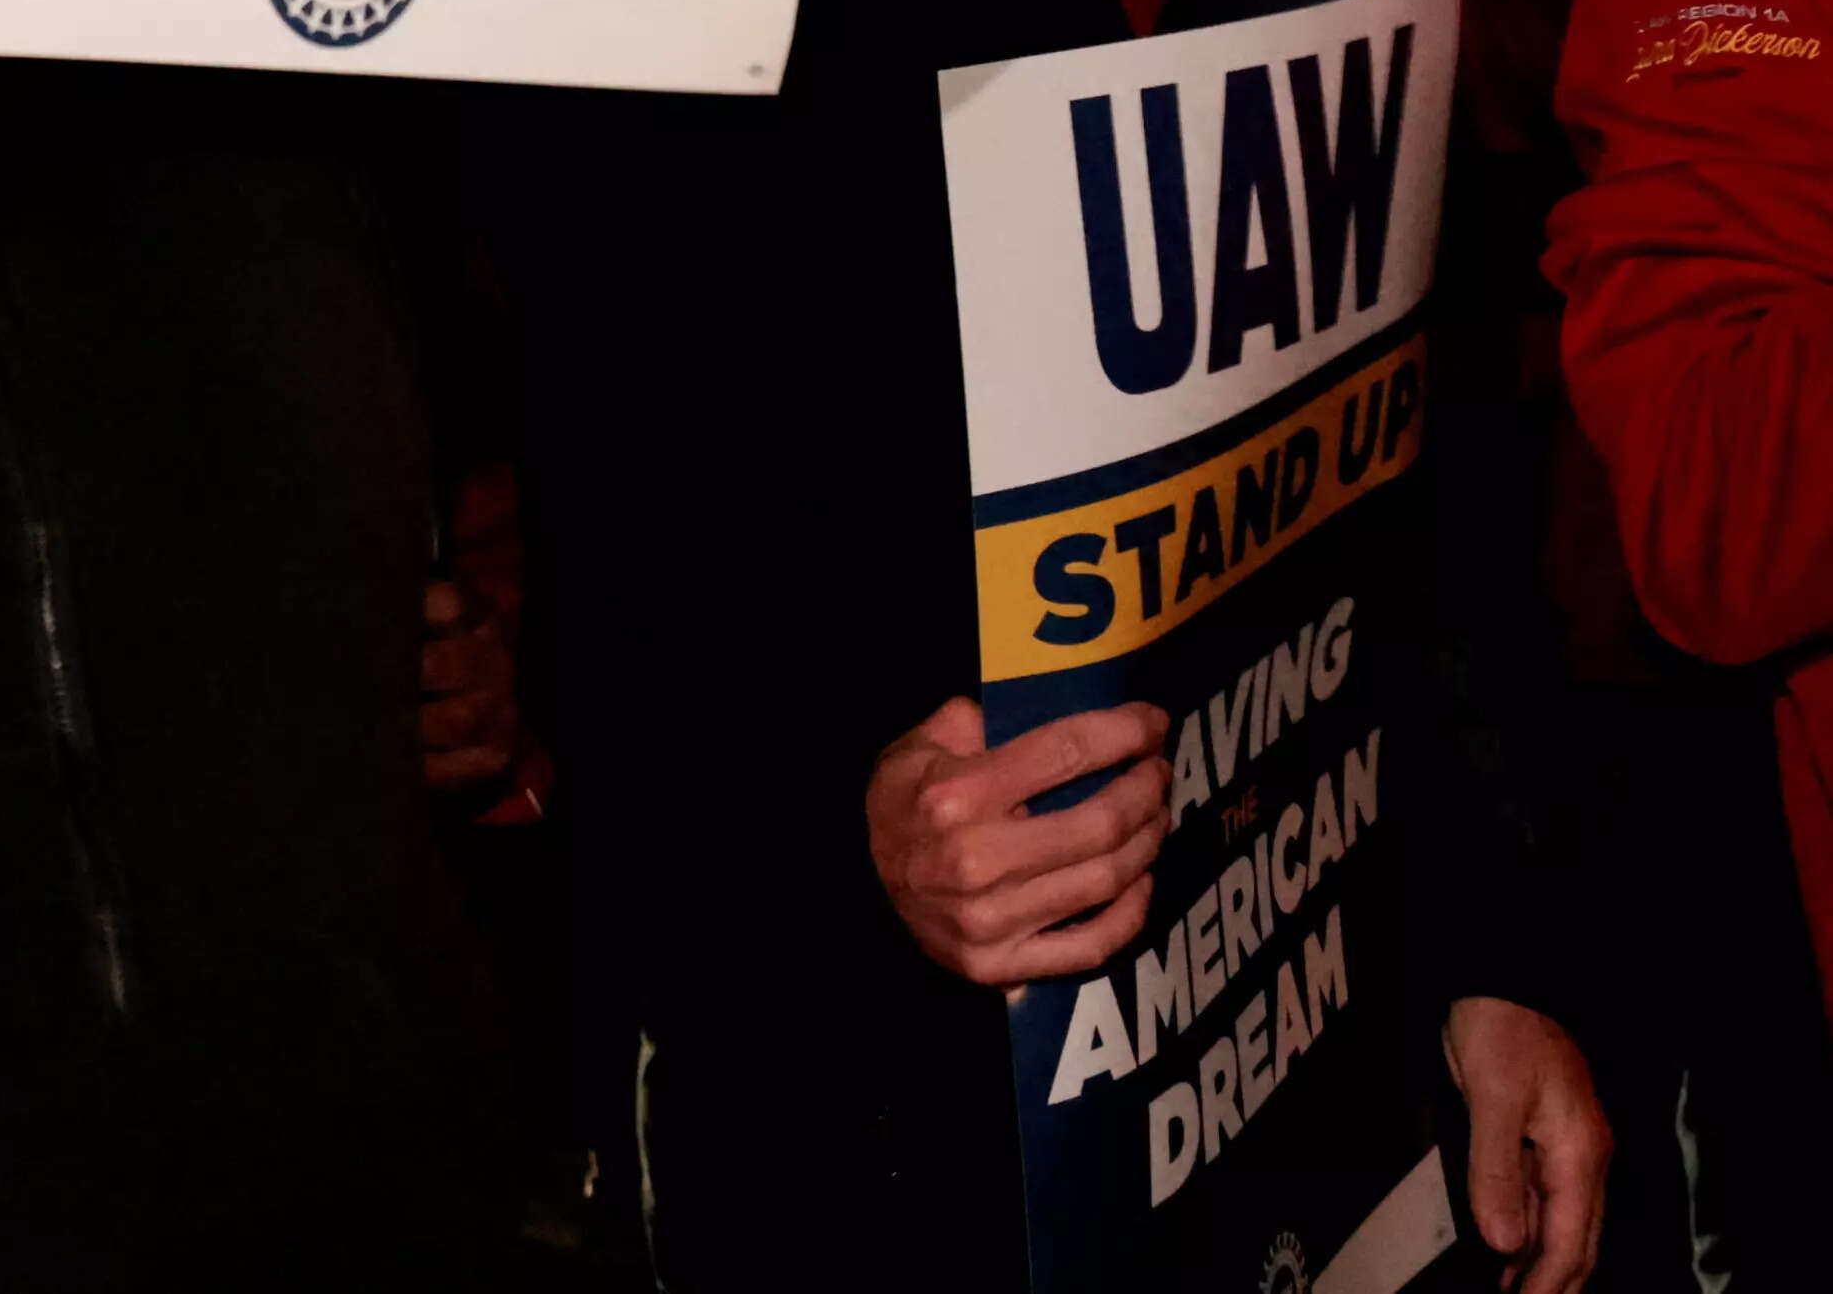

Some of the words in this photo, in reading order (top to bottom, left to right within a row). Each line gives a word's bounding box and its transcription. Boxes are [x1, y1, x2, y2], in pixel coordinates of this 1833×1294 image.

[1069, 22, 1416, 396] UAW
[1033, 425, 1320, 646] STAND
[1338, 359, 1419, 486] UP
[1169, 596, 1355, 834] AVING
[1047, 726, 1382, 1106] AMERICAN
[1148, 906, 1349, 1208] DREAM
